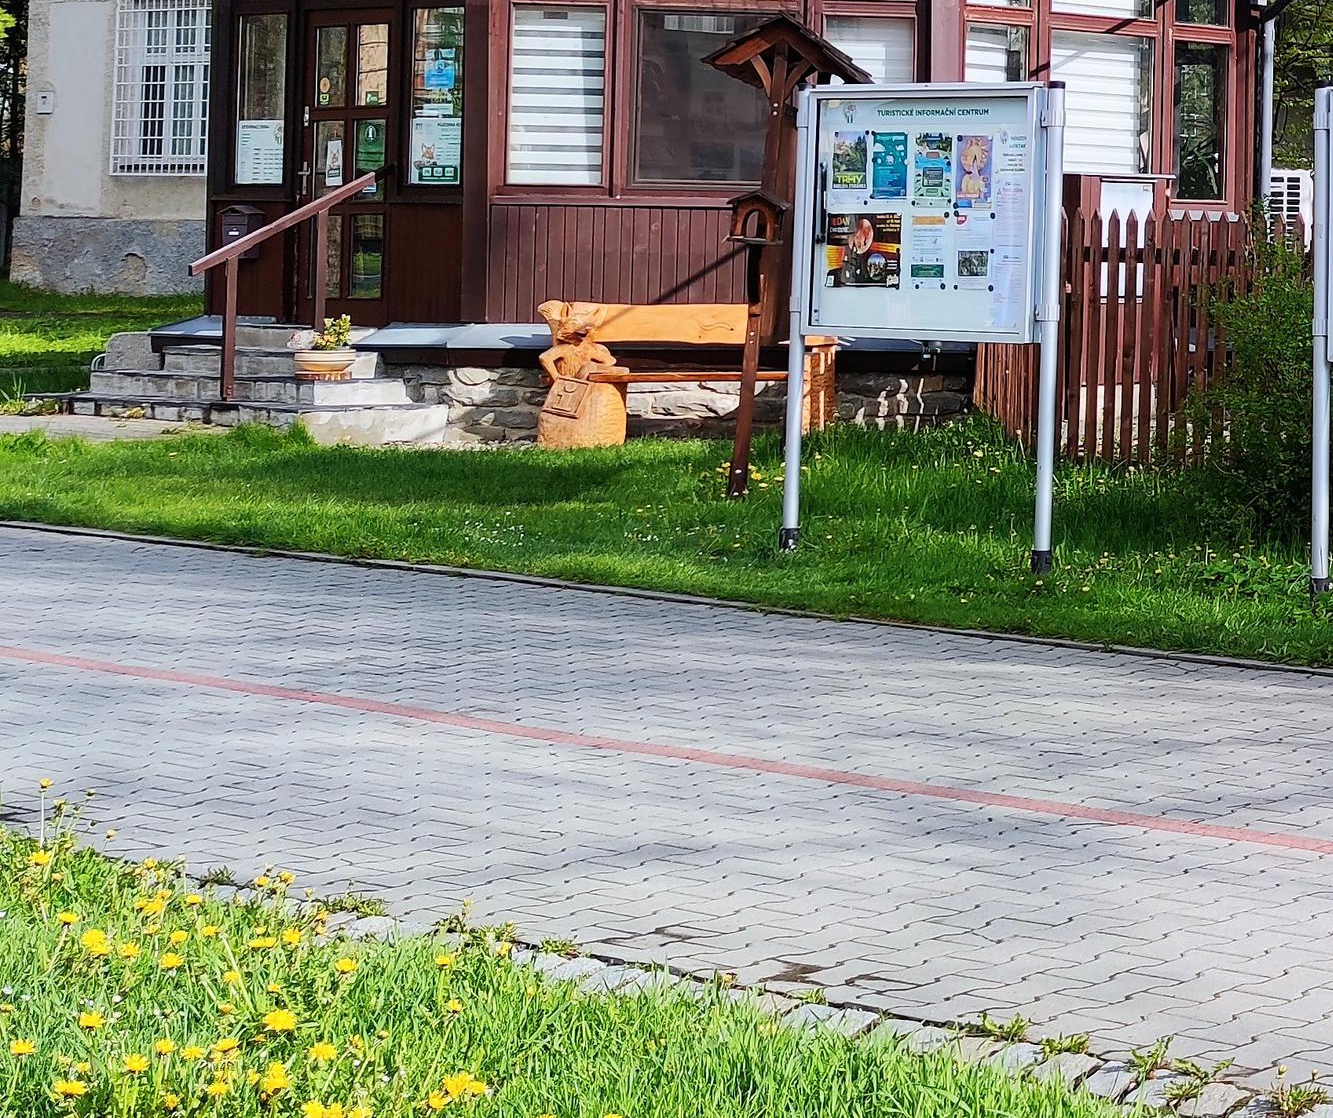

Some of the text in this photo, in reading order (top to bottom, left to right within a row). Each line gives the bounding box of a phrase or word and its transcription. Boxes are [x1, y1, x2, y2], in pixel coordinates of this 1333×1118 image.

[877, 107, 990, 117] TURISTICKÉ INFORMAČNÍ CENTRUM
[836, 174, 865, 184] TRHY
